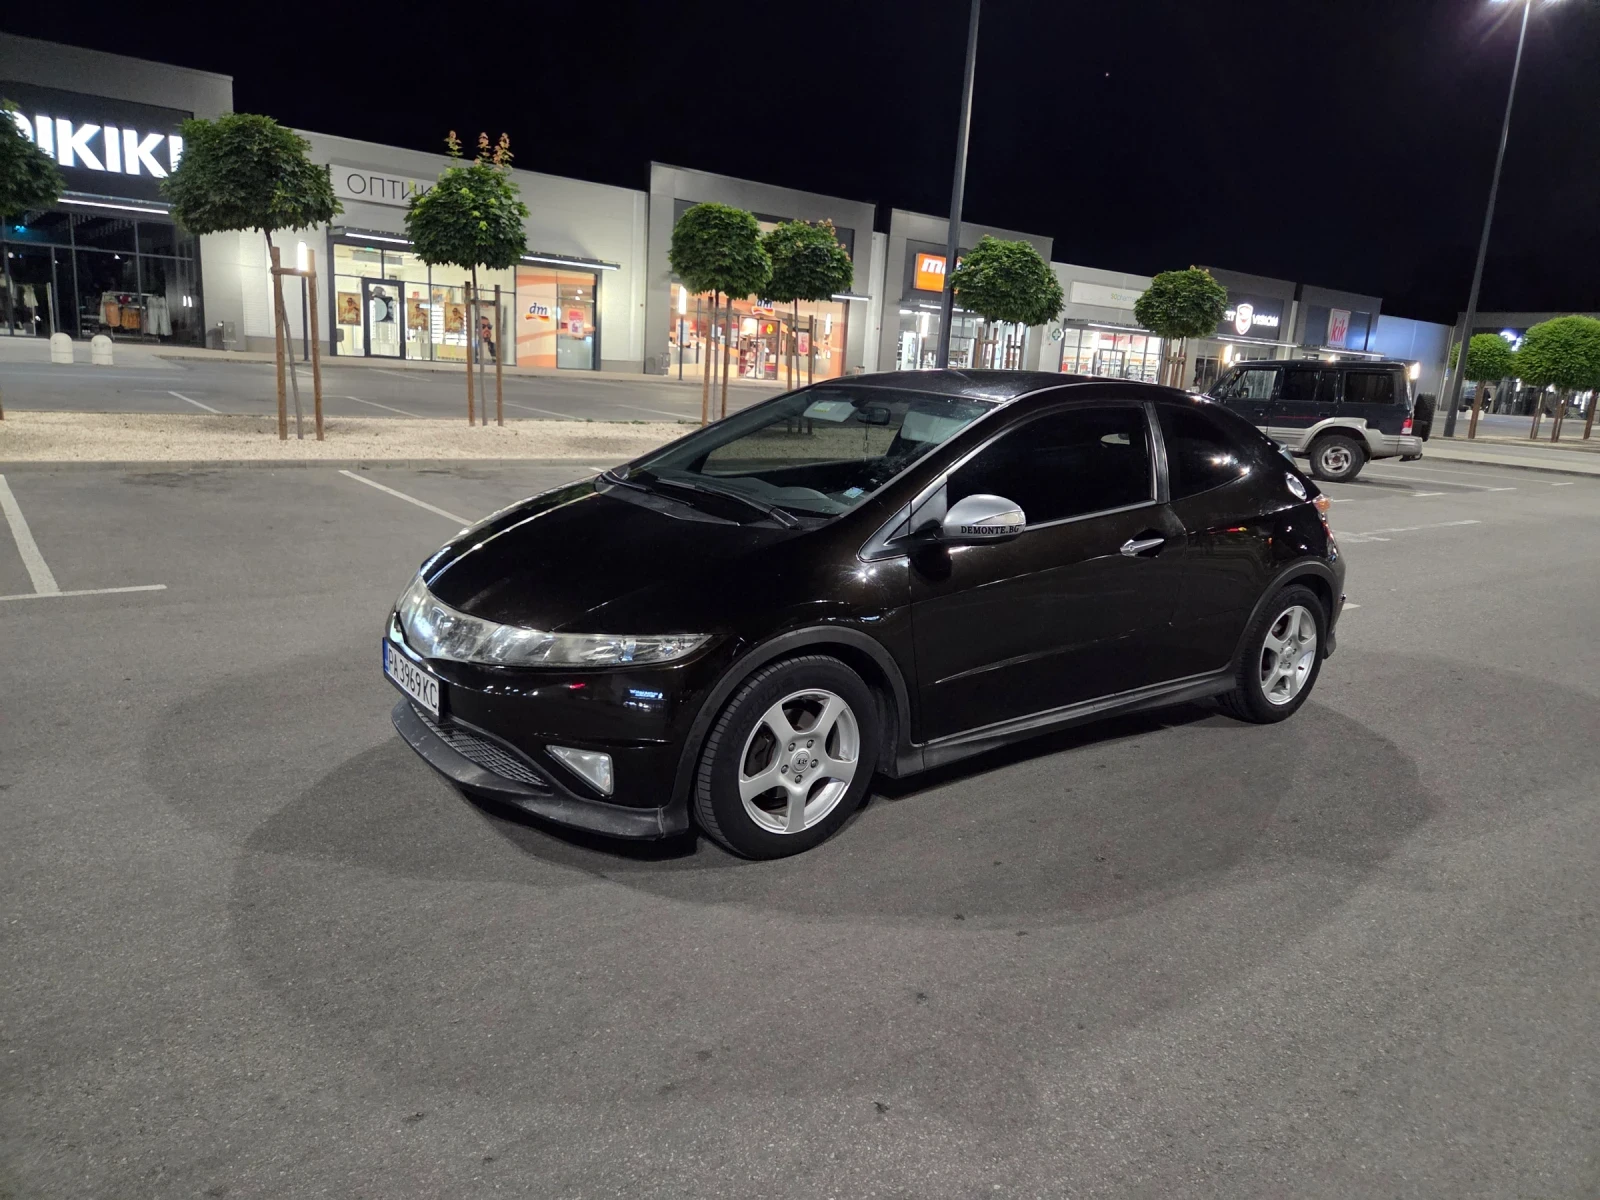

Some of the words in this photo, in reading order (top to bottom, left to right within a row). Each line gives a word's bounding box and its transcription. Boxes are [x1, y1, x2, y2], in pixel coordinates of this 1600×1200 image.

[529, 302, 548, 315] dm
[1252, 313, 1279, 327] VISION
[961, 525, 1019, 534] DEMONTE.BG
